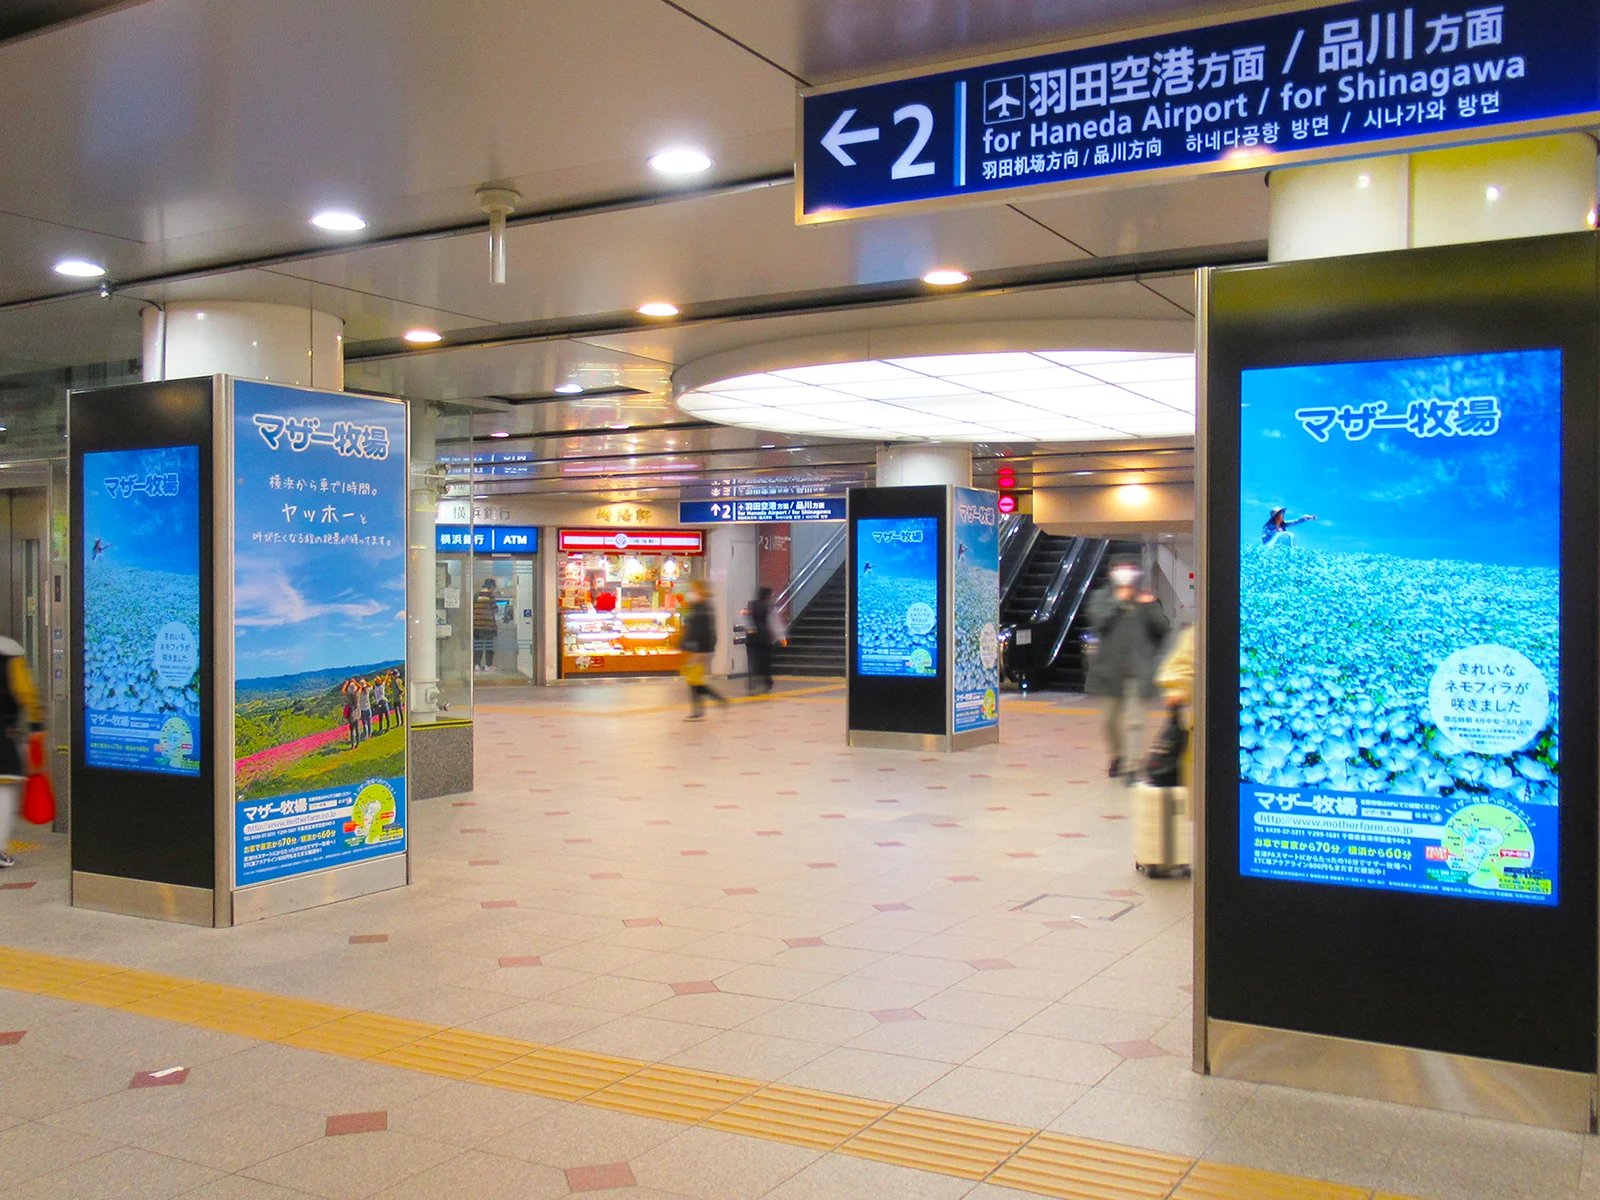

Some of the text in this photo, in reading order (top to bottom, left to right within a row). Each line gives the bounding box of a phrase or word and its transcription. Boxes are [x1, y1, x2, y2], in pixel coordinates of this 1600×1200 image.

[1029, 45, 1266, 118] 羽田空港方面
[1318, 6, 1505, 72] 品川方面
[983, 127, 1022, 154] for
[1030, 113, 1133, 148] Haneda
[1141, 93, 1249, 133] Airport
[1280, 82, 1328, 112] for
[1338, 56, 1526, 103] Shinagawa
[1186, 121, 1280, 153] 하네다공항
[1291, 114, 1330, 141] 방면
[1363, 98, 1447, 130] 시나가와
[1457, 90, 1501, 118] 방면
[891, 103, 936, 181] 2
[982, 149, 1079, 181] 羽田机场方向
[1094, 136, 1163, 165] 品川方向
[1295, 395, 1502, 444] マザー牧場
[252, 413, 391, 461] マザー牧場
[103, 472, 180, 499] マザー牧場
[269, 474, 378, 497] 横浜から車で1時間。
[282, 503, 368, 525] ヤッホーと
[722, 504, 732, 519] 2
[959, 504, 996, 526] マザー牧場
[503, 535, 528, 545] ATM
[872, 529, 924, 543] マザー牧場
[1458, 662, 1516, 677] きれいな
[1445, 679, 1530, 695] ネモフィラが
[1451, 698, 1521, 714] 咲きました
[243, 798, 308, 821] マザー牧場
[1254, 791, 1358, 816] マザー牧場
